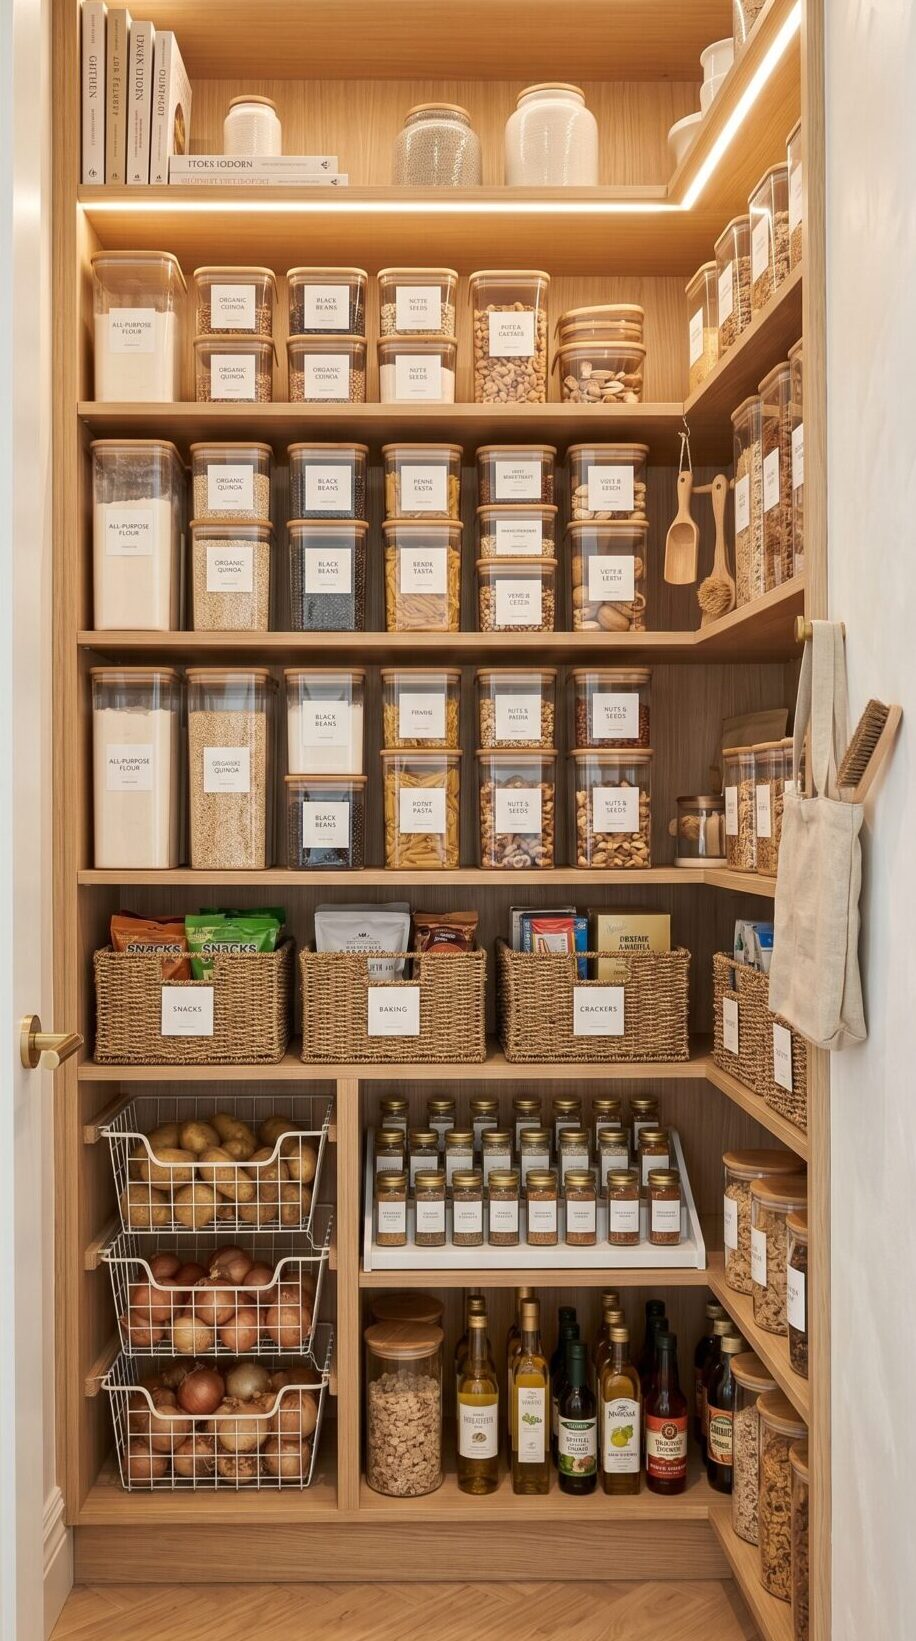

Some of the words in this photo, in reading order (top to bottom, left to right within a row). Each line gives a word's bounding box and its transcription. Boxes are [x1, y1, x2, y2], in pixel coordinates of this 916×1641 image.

[127, 944, 182, 954] SNACKS
[172, 1005, 202, 1013] SNACKS
[579, 1005, 618, 1013] CRACKERS
